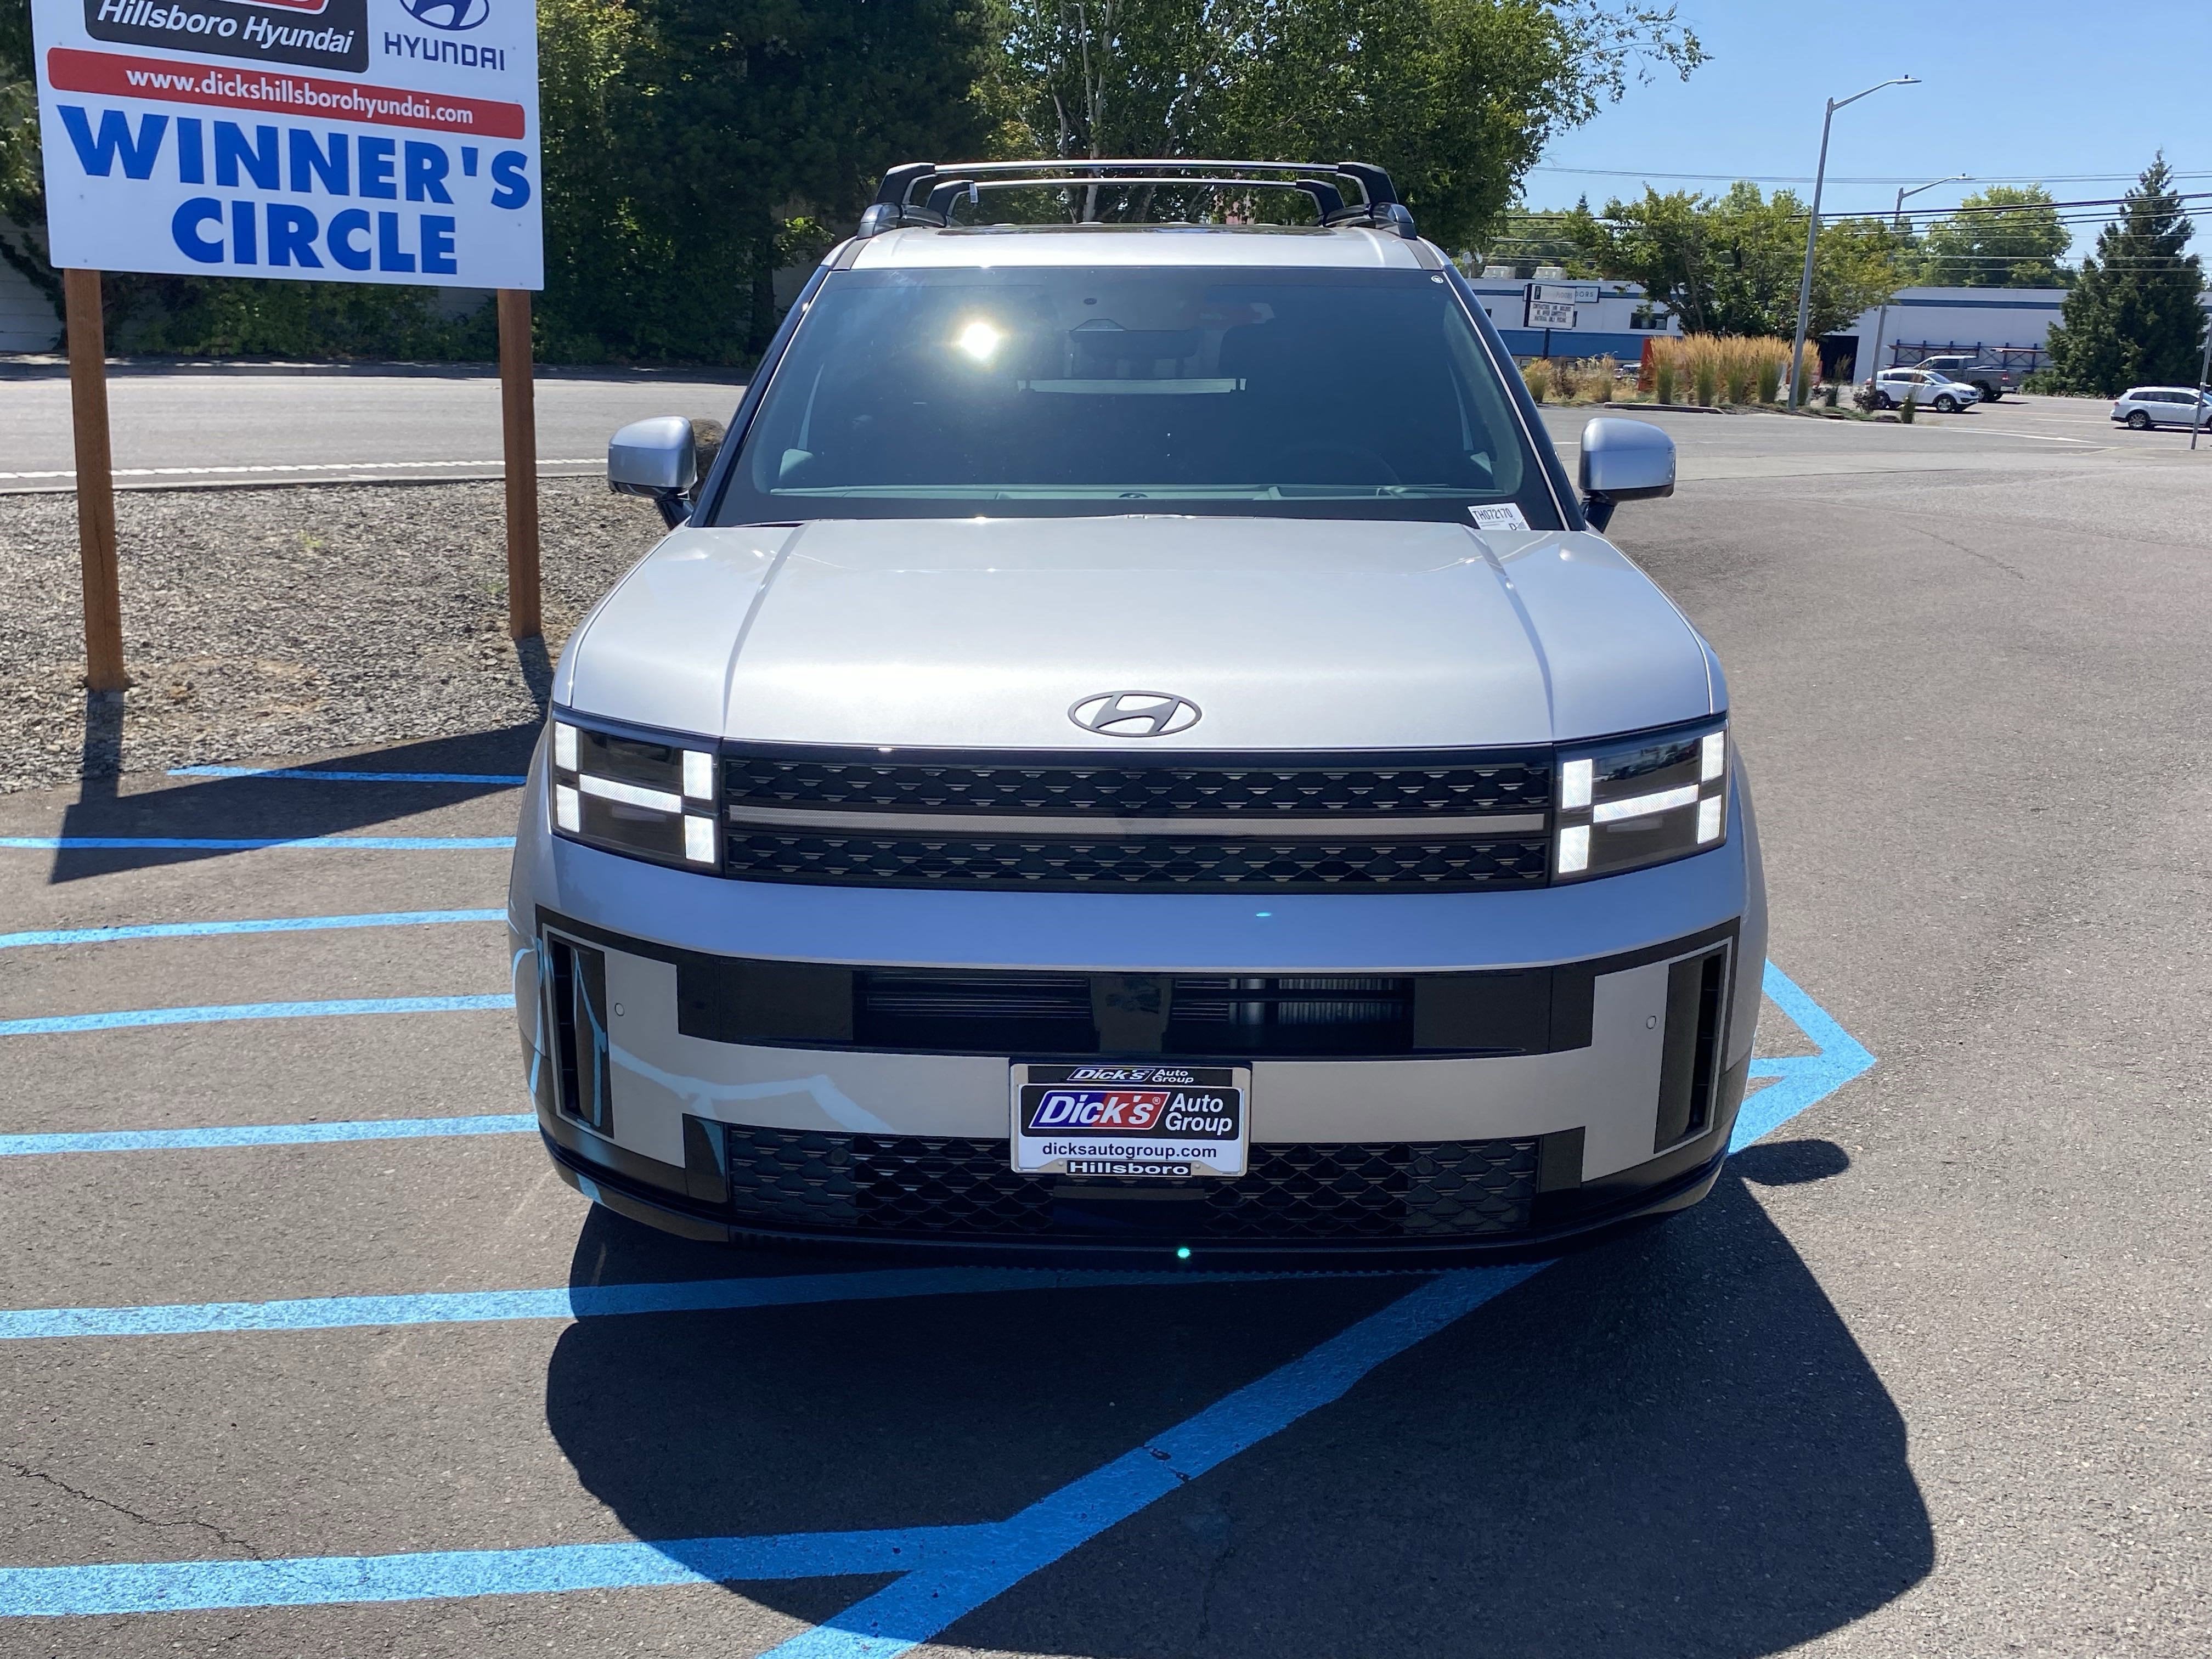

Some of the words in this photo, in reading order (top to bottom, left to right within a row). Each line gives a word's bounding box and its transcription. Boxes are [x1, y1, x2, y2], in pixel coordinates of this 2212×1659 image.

[97, 0, 237, 37] Hillsboro
[242, 16, 355, 54] Hyundai
[384, 31, 505, 71] HYUNDAI
[126, 69, 473, 125] www.dickshillsborohyundai.com
[57, 105, 531, 210] WINNER'S
[172, 197, 458, 275] CIRCLE
[1472, 508, 1513, 521] TH072170
[1073, 1069, 1146, 1080] Dick's
[1152, 1075, 1194, 1084] Group
[1039, 1094, 1154, 1125] Dick's
[1169, 1093, 1223, 1113] Auto
[1165, 1113, 1233, 1136] Group
[1042, 1142, 1217, 1159] dicksautogroup.com
[1070, 1162, 1189, 1175] Hillsboro
